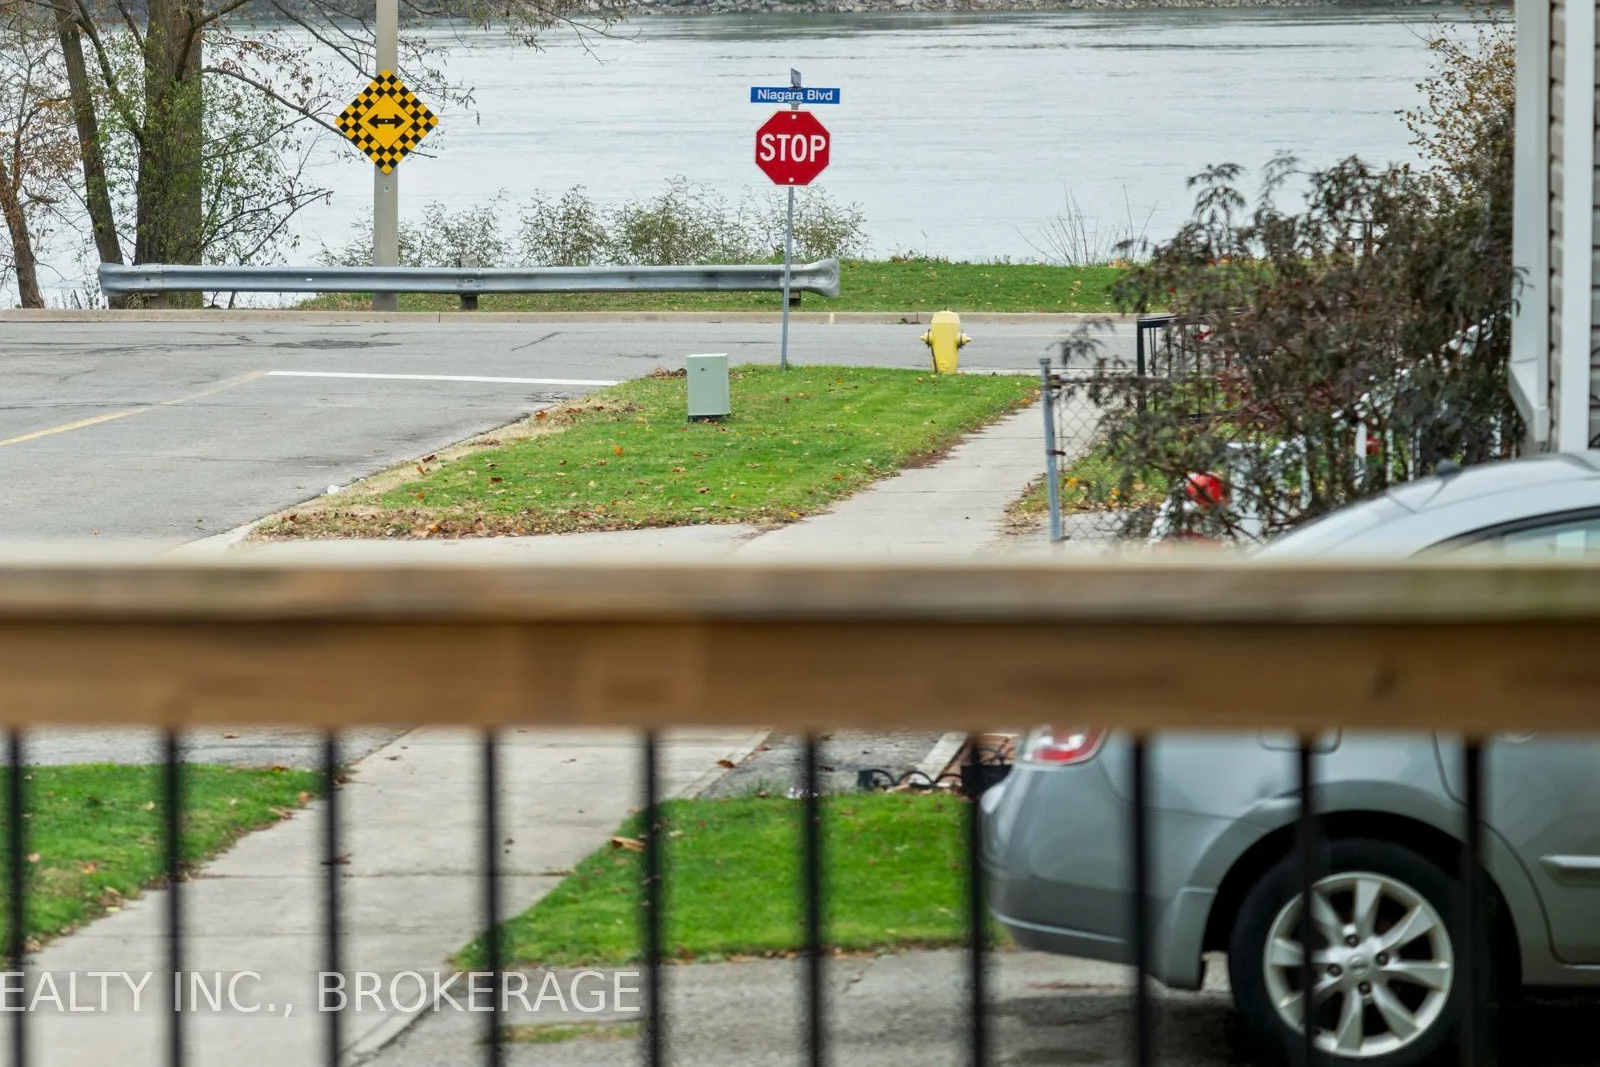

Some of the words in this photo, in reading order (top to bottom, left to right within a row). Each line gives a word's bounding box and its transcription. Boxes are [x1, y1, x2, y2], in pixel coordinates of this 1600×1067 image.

[758, 89, 803, 101] Niagara
[807, 90, 833, 100] Blvd
[760, 133, 826, 162] STOP
